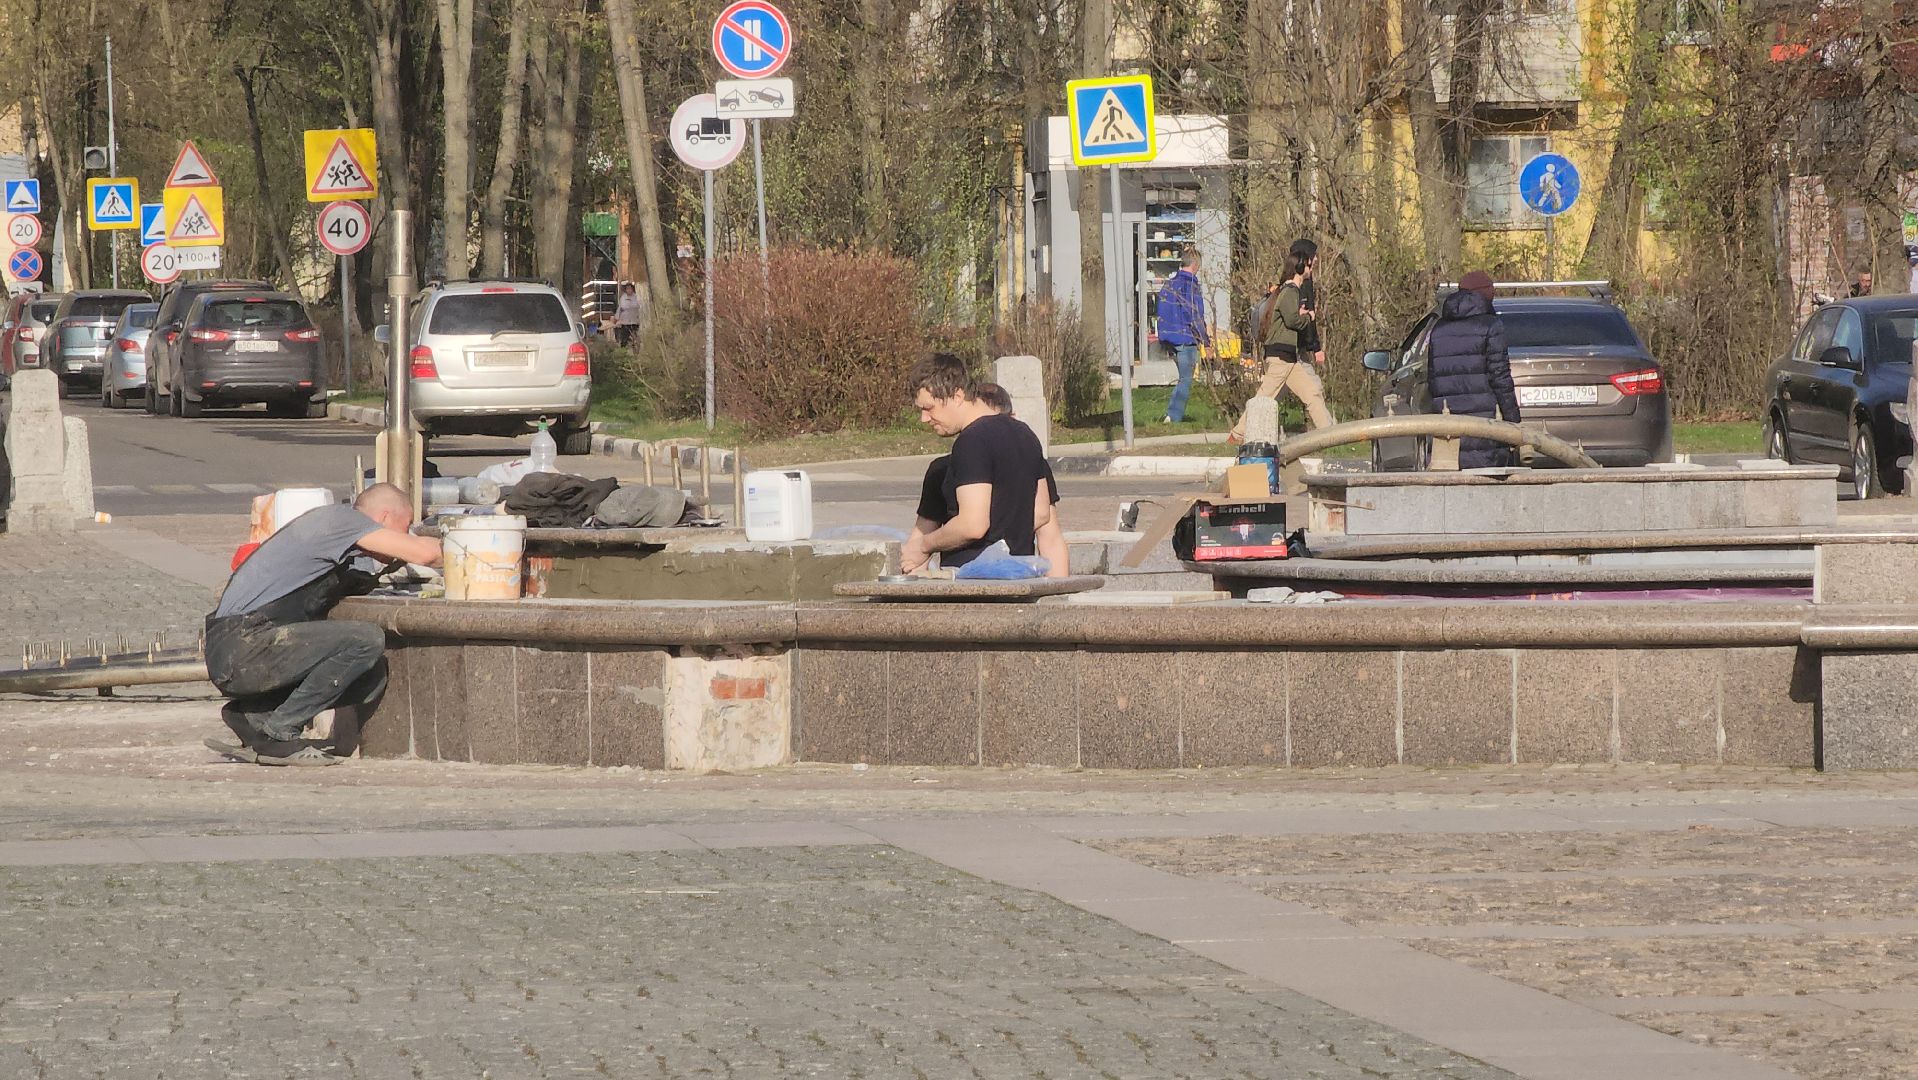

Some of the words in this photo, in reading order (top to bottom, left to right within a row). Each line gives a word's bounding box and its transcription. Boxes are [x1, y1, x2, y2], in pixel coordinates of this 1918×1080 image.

[15, 223, 33, 237] 20
[328, 217, 359, 239] 40
[151, 254, 175, 271] 20
[1575, 386, 1594, 397] 790
[1218, 504, 1266, 513] Einhell
